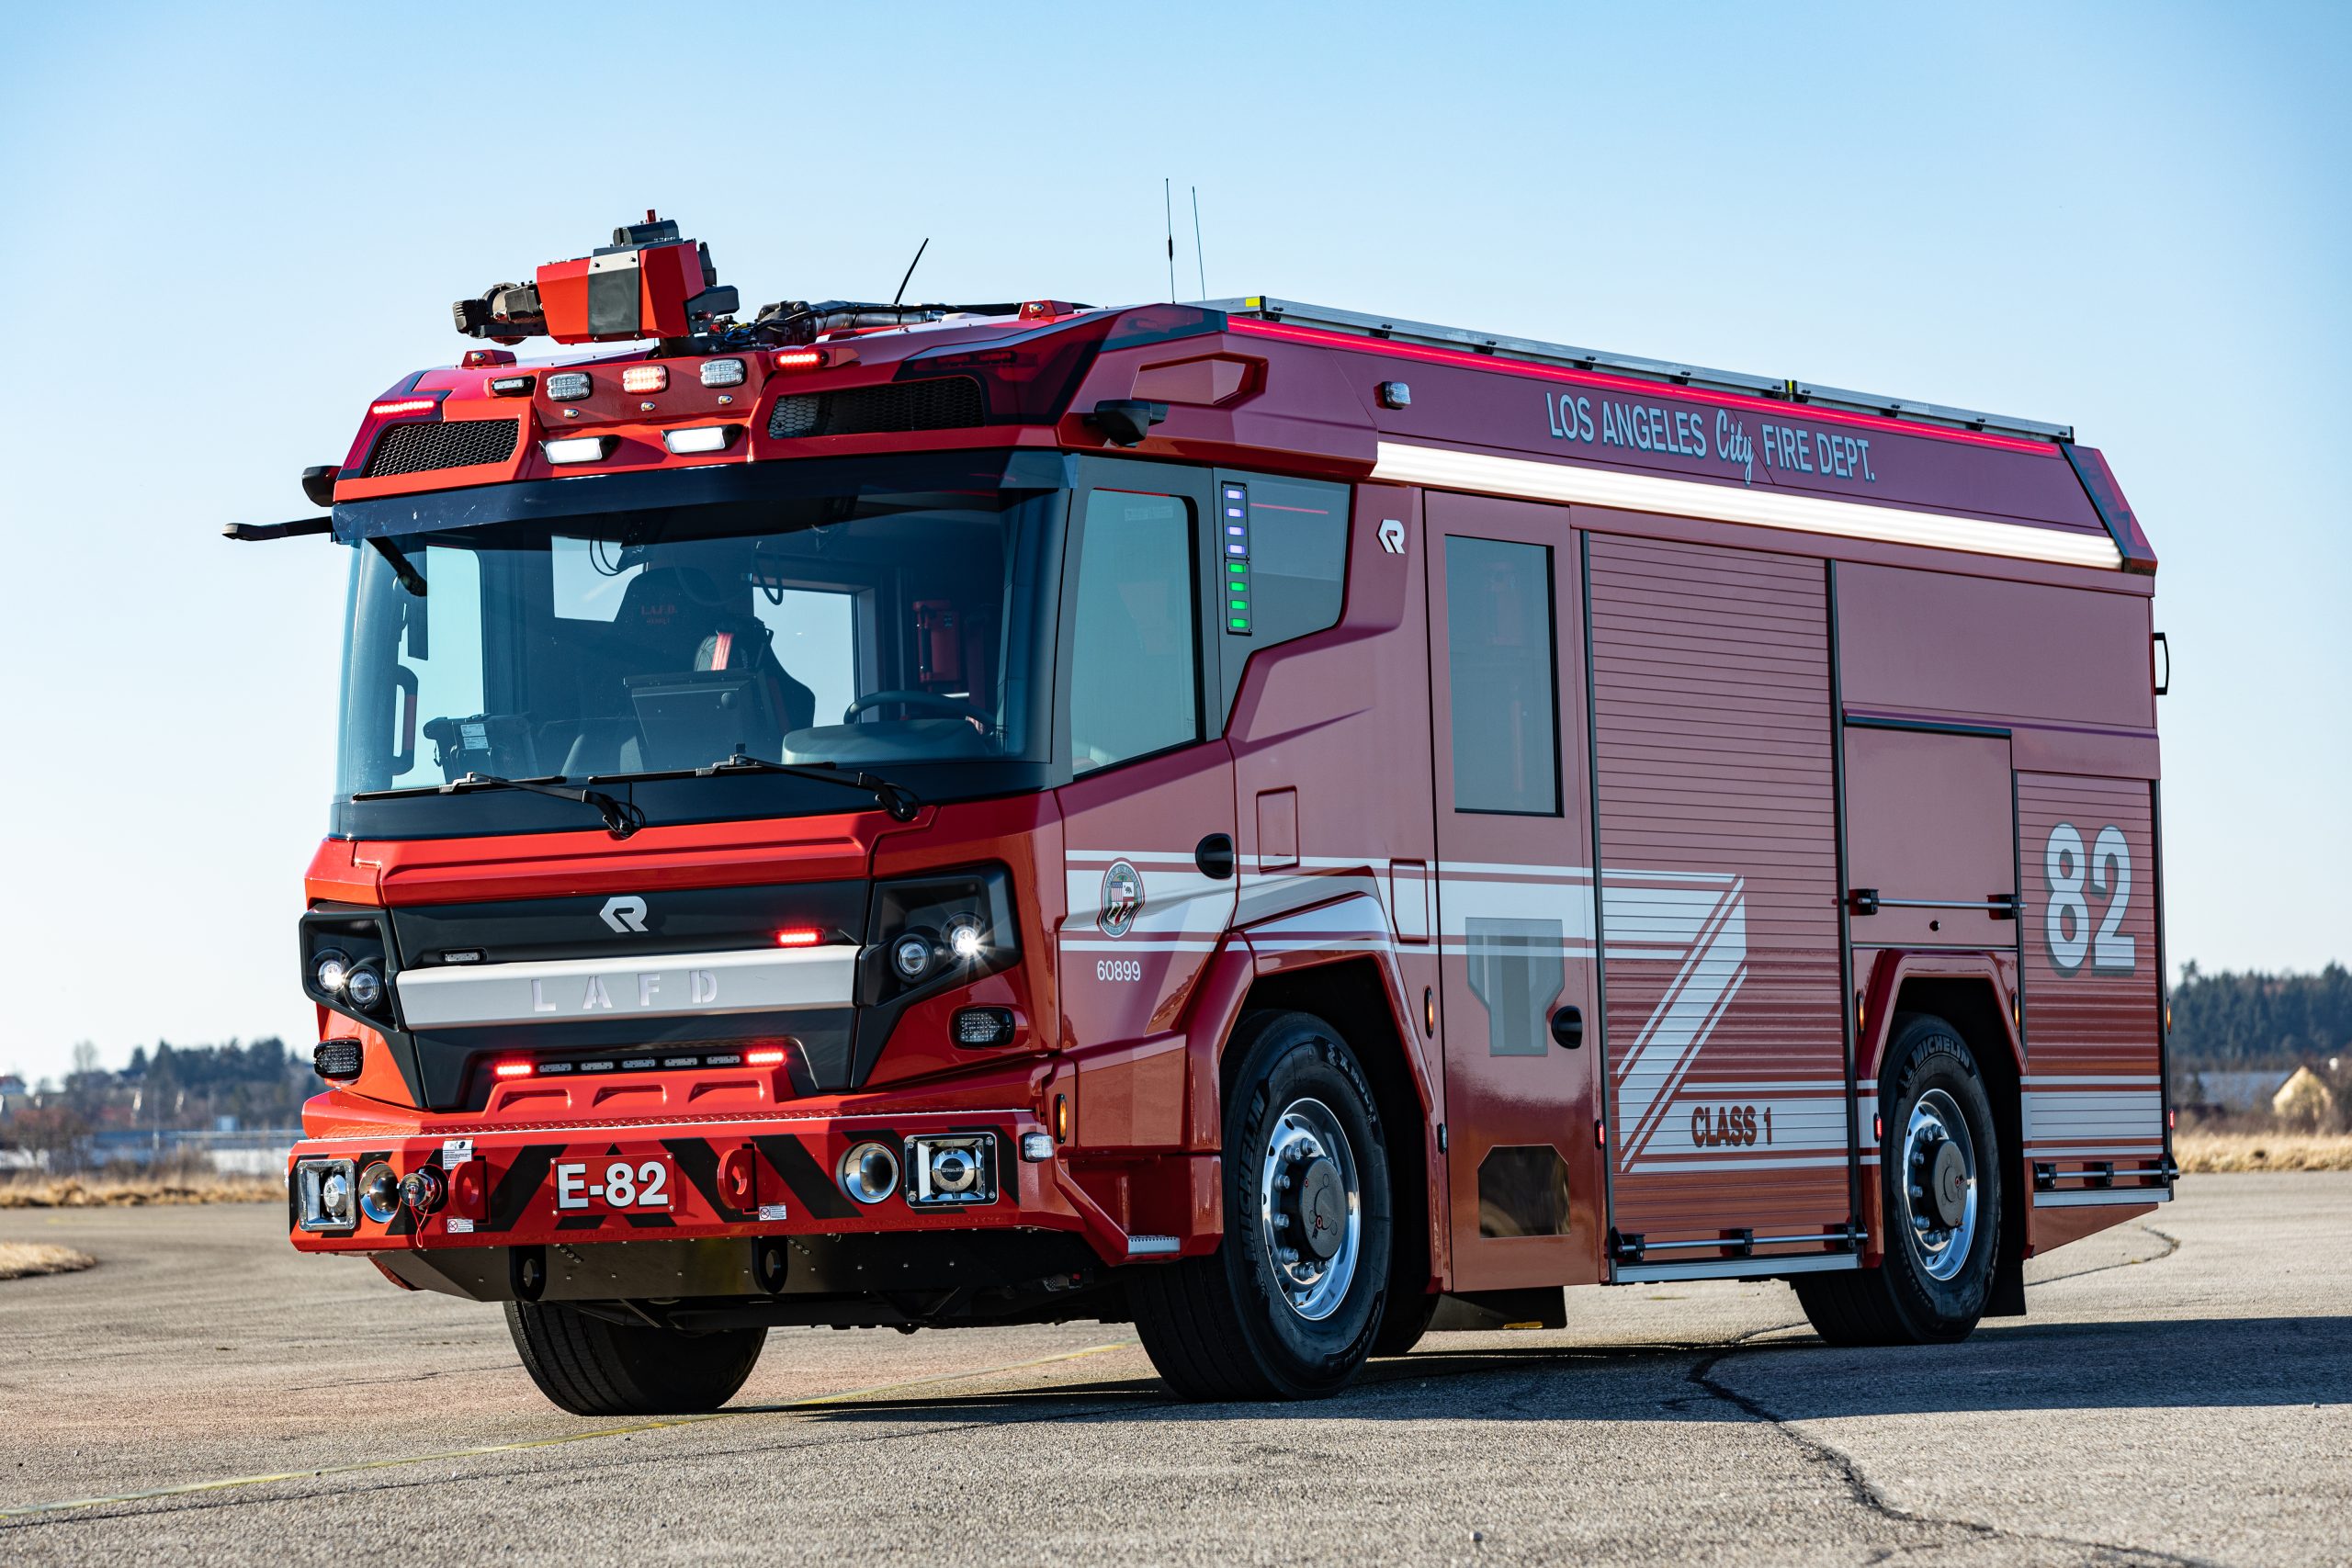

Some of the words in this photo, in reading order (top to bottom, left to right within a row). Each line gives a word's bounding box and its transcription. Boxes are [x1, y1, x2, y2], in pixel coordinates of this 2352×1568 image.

[1546, 391, 1595, 444] LOS
[1602, 400, 1708, 459] ANGELES
[1715, 409, 1754, 485] City
[1761, 423, 1814, 474] FIRE
[1815, 432, 1876, 482] DEPT.
[2043, 821, 2136, 978] 82
[1097, 960, 1141, 981] 60899
[1911, 1035, 1970, 1070] MICHELIN
[1691, 1105, 1758, 1148] CLASS
[1764, 1107, 1772, 1145] 1
[557, 1161, 669, 1210] E-82
[1238, 1087, 1265, 1262] MICHELIN
